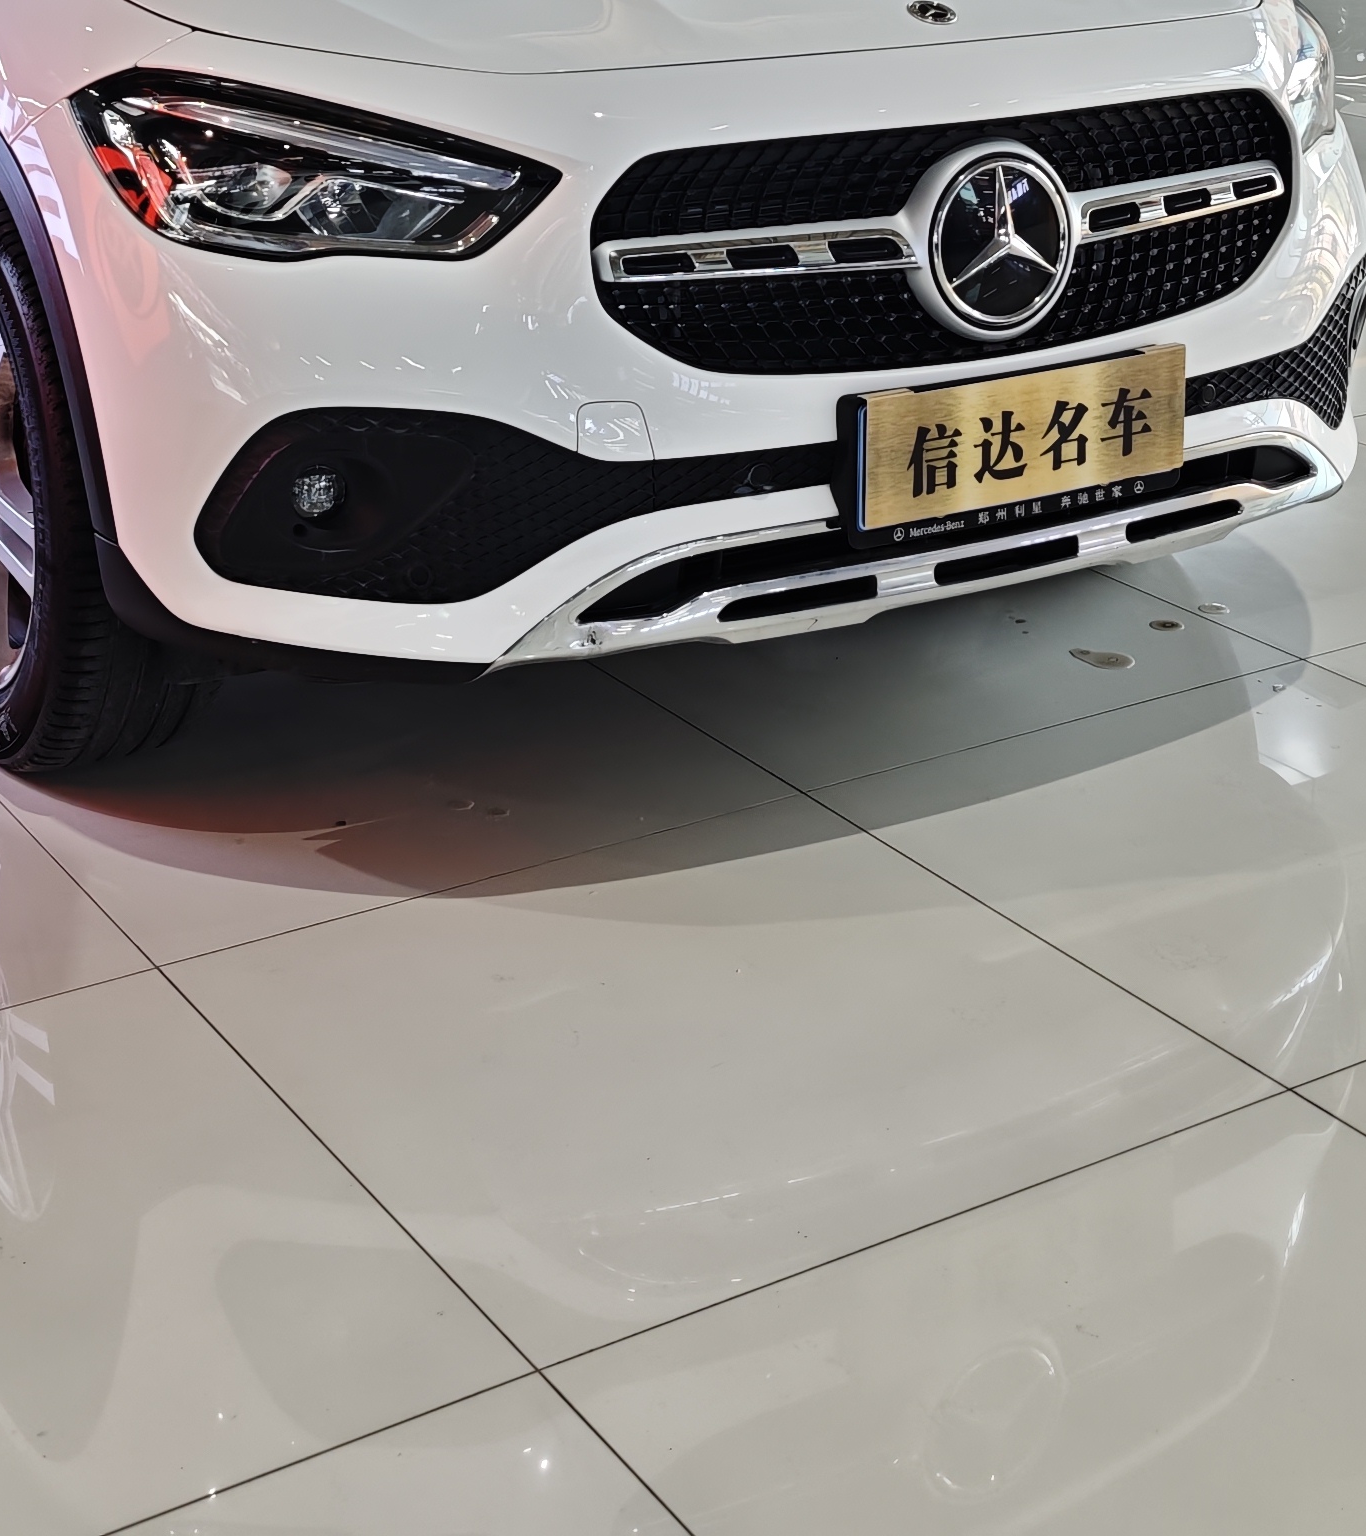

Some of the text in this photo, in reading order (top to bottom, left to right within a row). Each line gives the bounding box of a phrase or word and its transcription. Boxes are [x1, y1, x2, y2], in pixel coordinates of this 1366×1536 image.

[906, 386, 1154, 499] 信达名车
[908, 484, 1124, 539] Mercedes-Benz 郑州利星 奔驰世家
